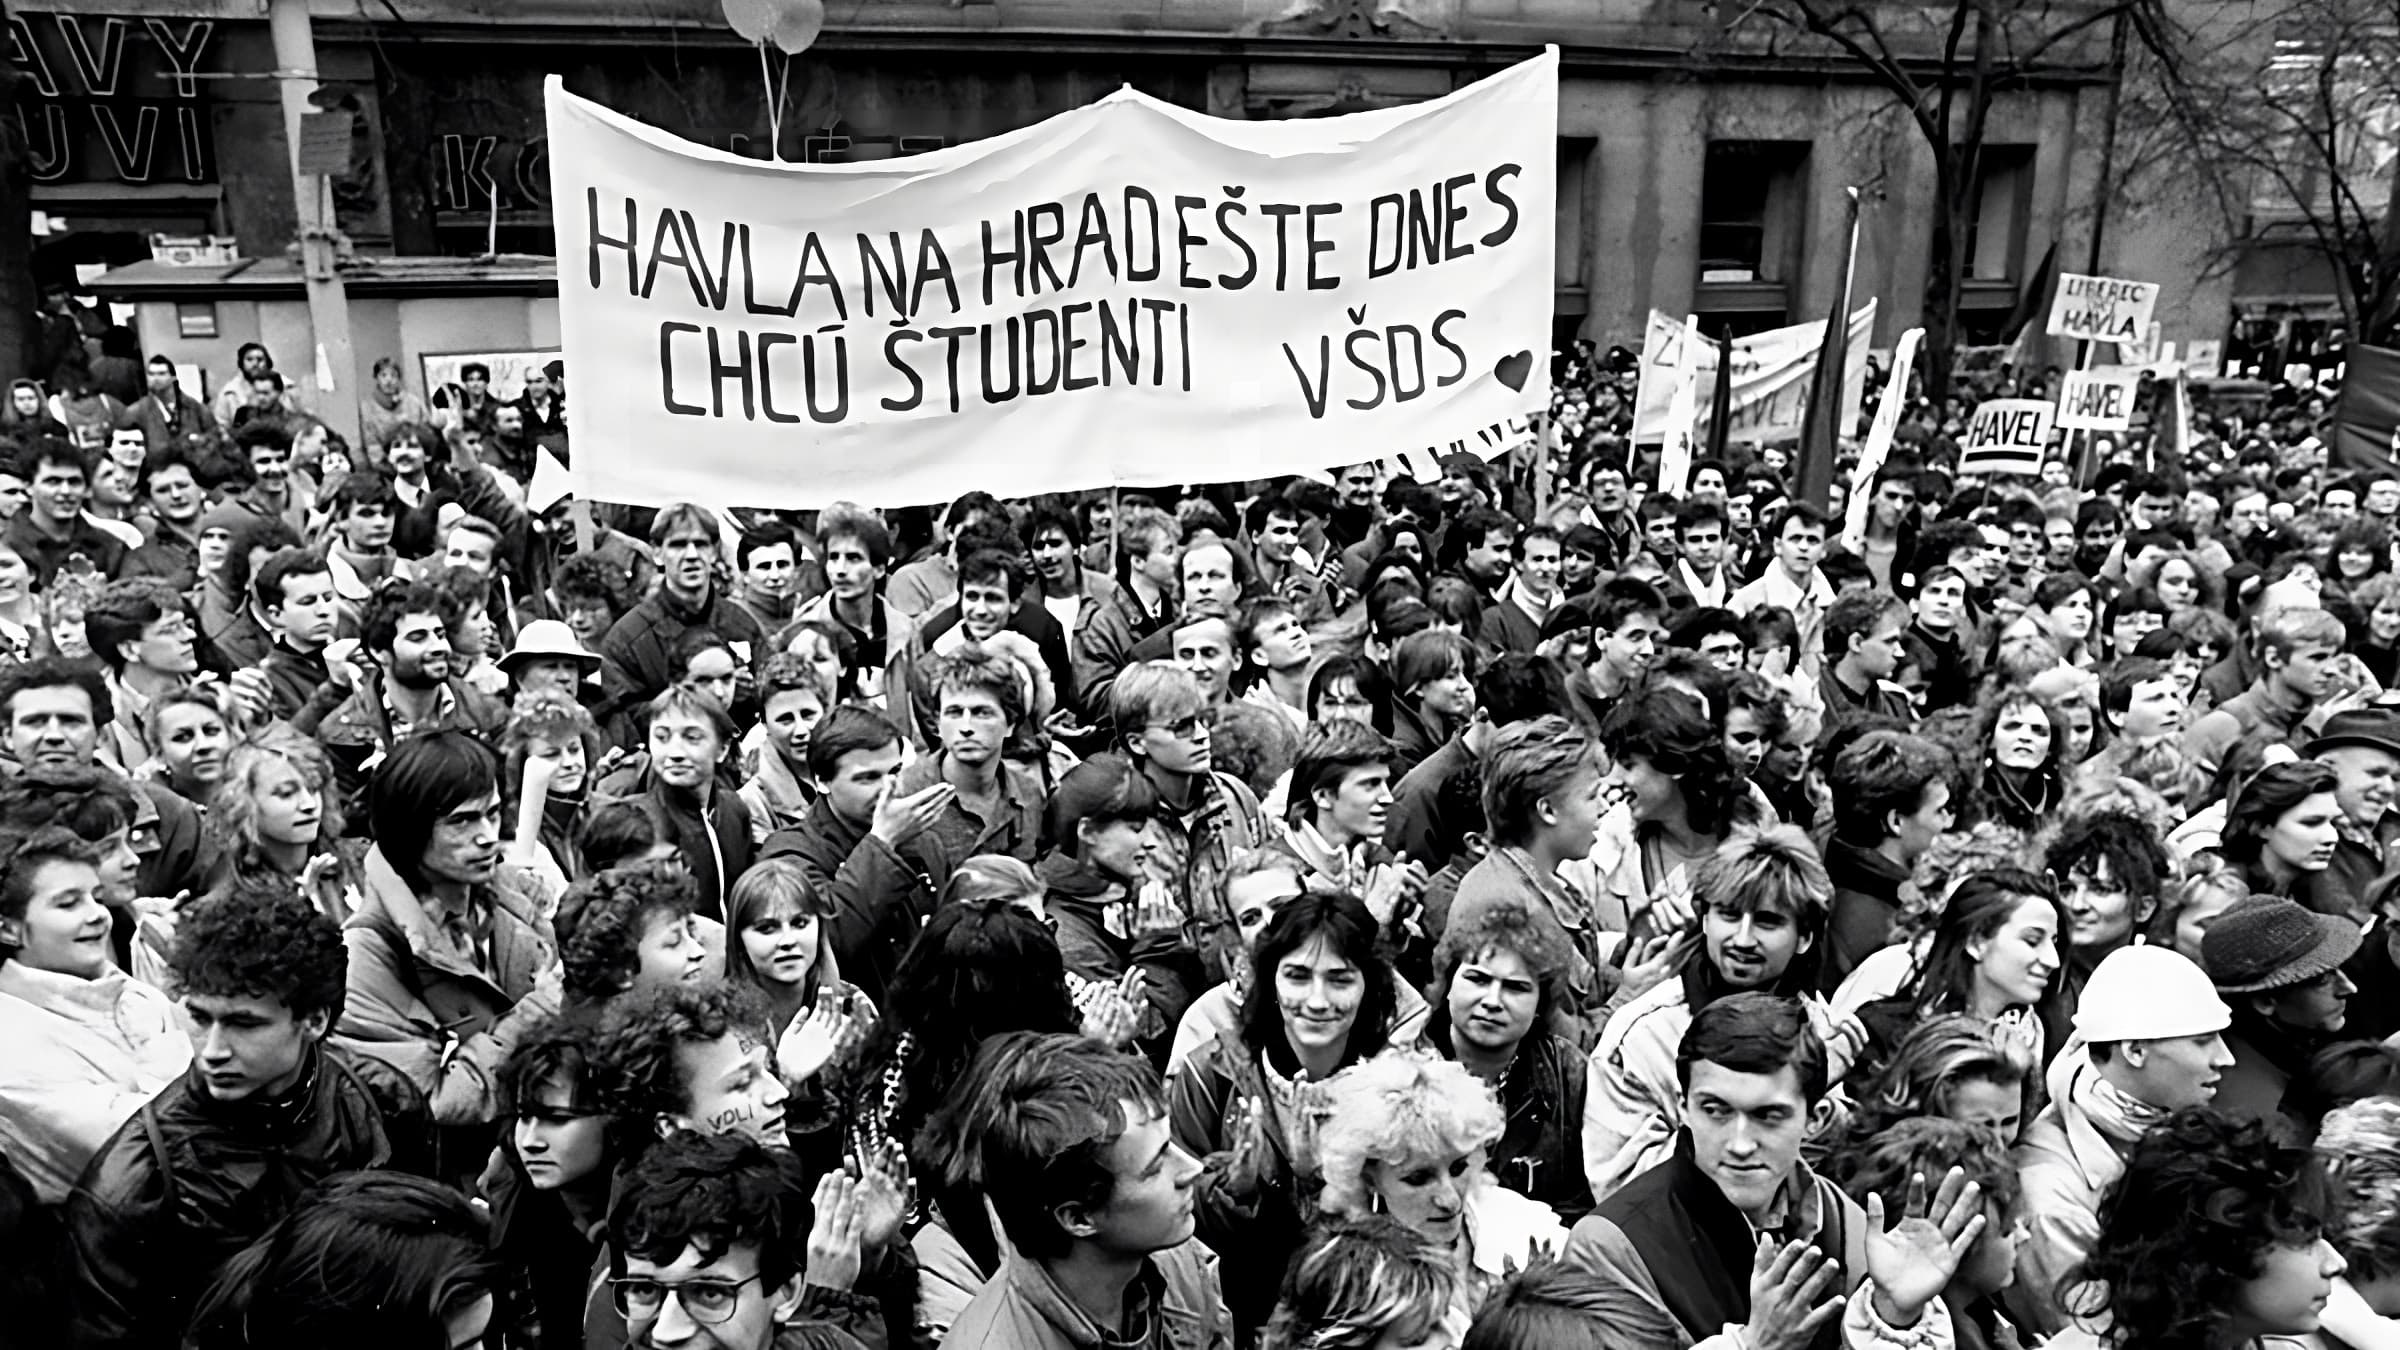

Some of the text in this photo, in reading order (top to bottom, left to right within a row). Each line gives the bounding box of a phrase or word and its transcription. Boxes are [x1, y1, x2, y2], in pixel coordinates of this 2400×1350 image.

[587, 163, 1522, 321] HAVLA NA HRAD EŠTE DNES
[2062, 309, 2137, 340] HAVLA
[660, 322, 849, 424] CHCÚ
[879, 297, 1191, 414] ŠTUDENTI
[2066, 382, 2125, 419] HAVEL
[1968, 410, 2043, 448] HAVEL
